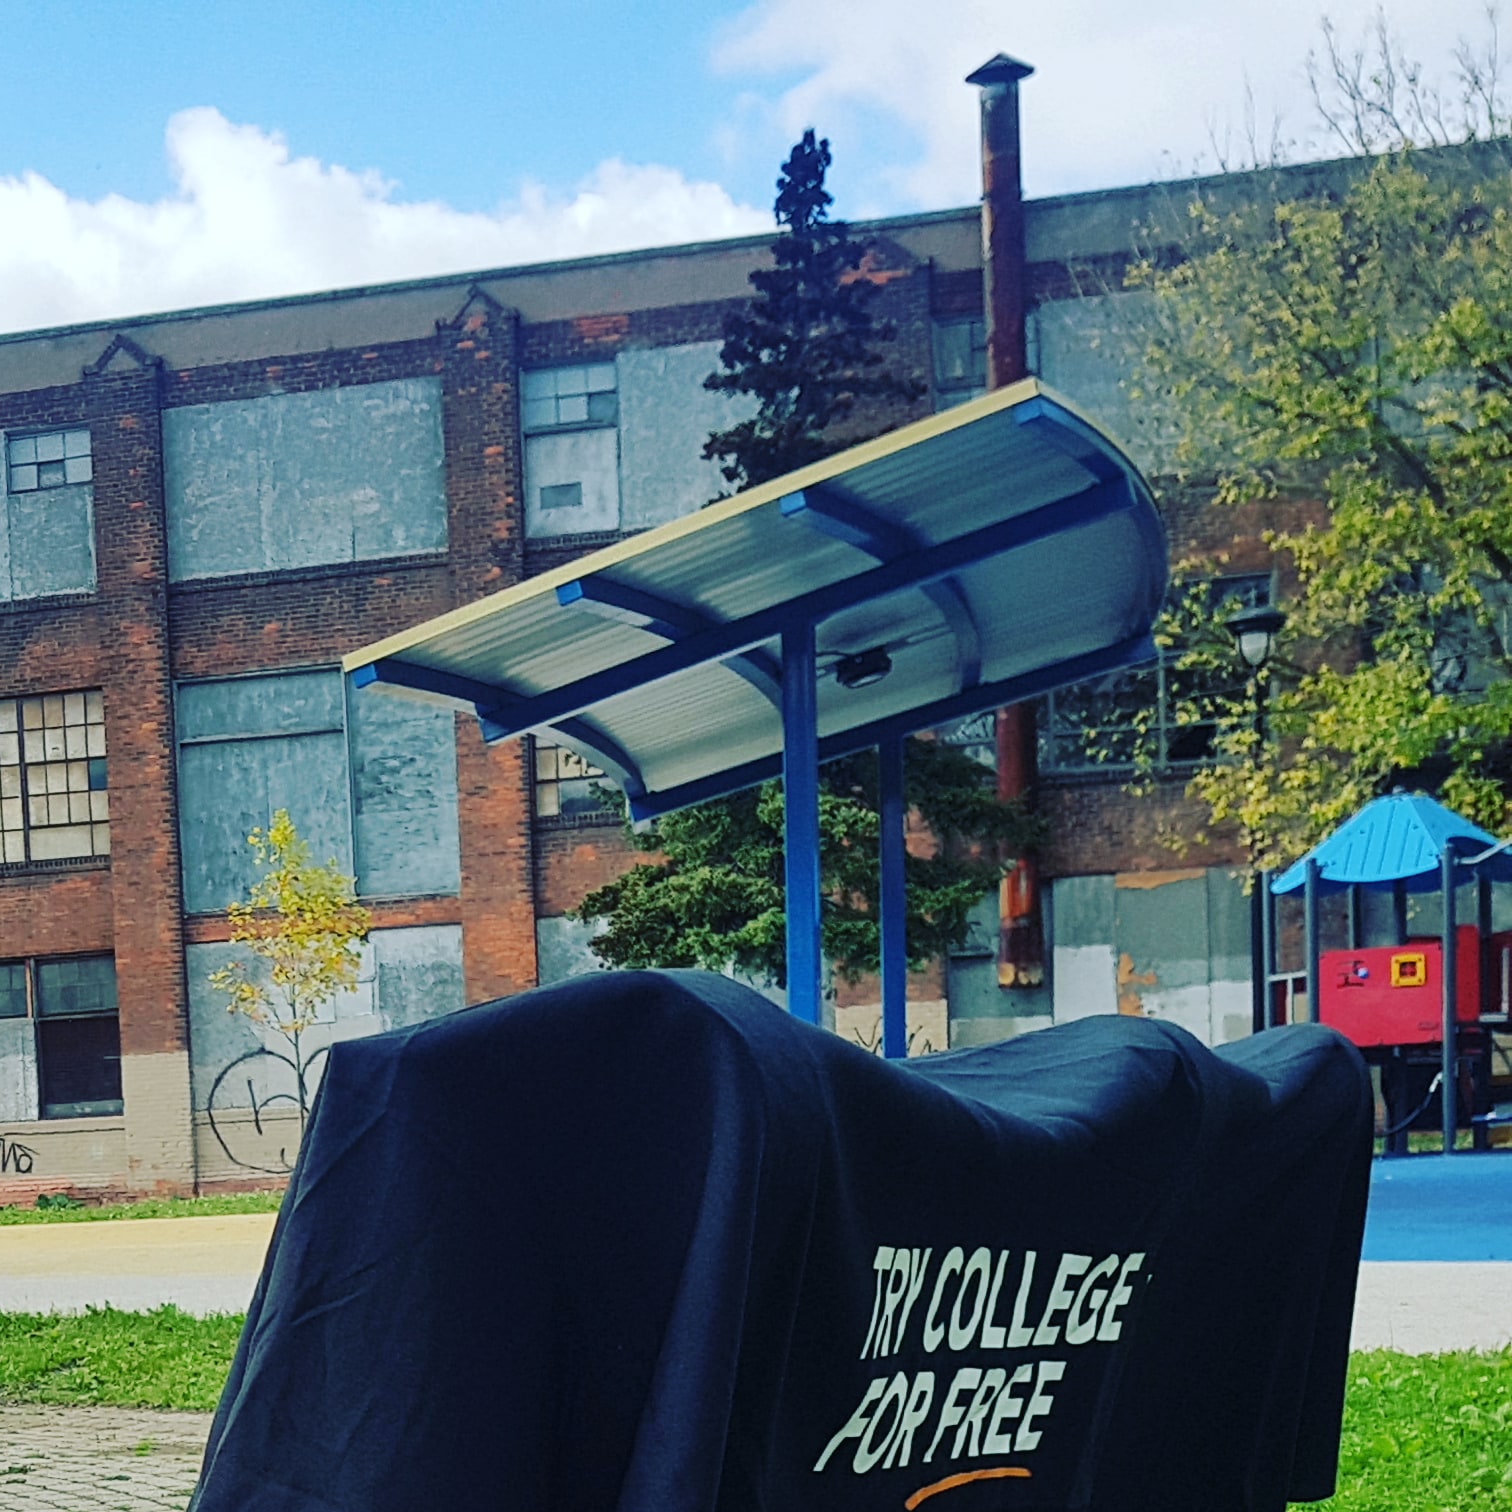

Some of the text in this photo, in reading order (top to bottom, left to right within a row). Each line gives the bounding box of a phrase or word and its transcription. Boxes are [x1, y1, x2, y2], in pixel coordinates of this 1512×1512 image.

[859, 1246, 1146, 1360] TRY COLLEGE
[813, 1361, 1067, 1474] FOR FREE
